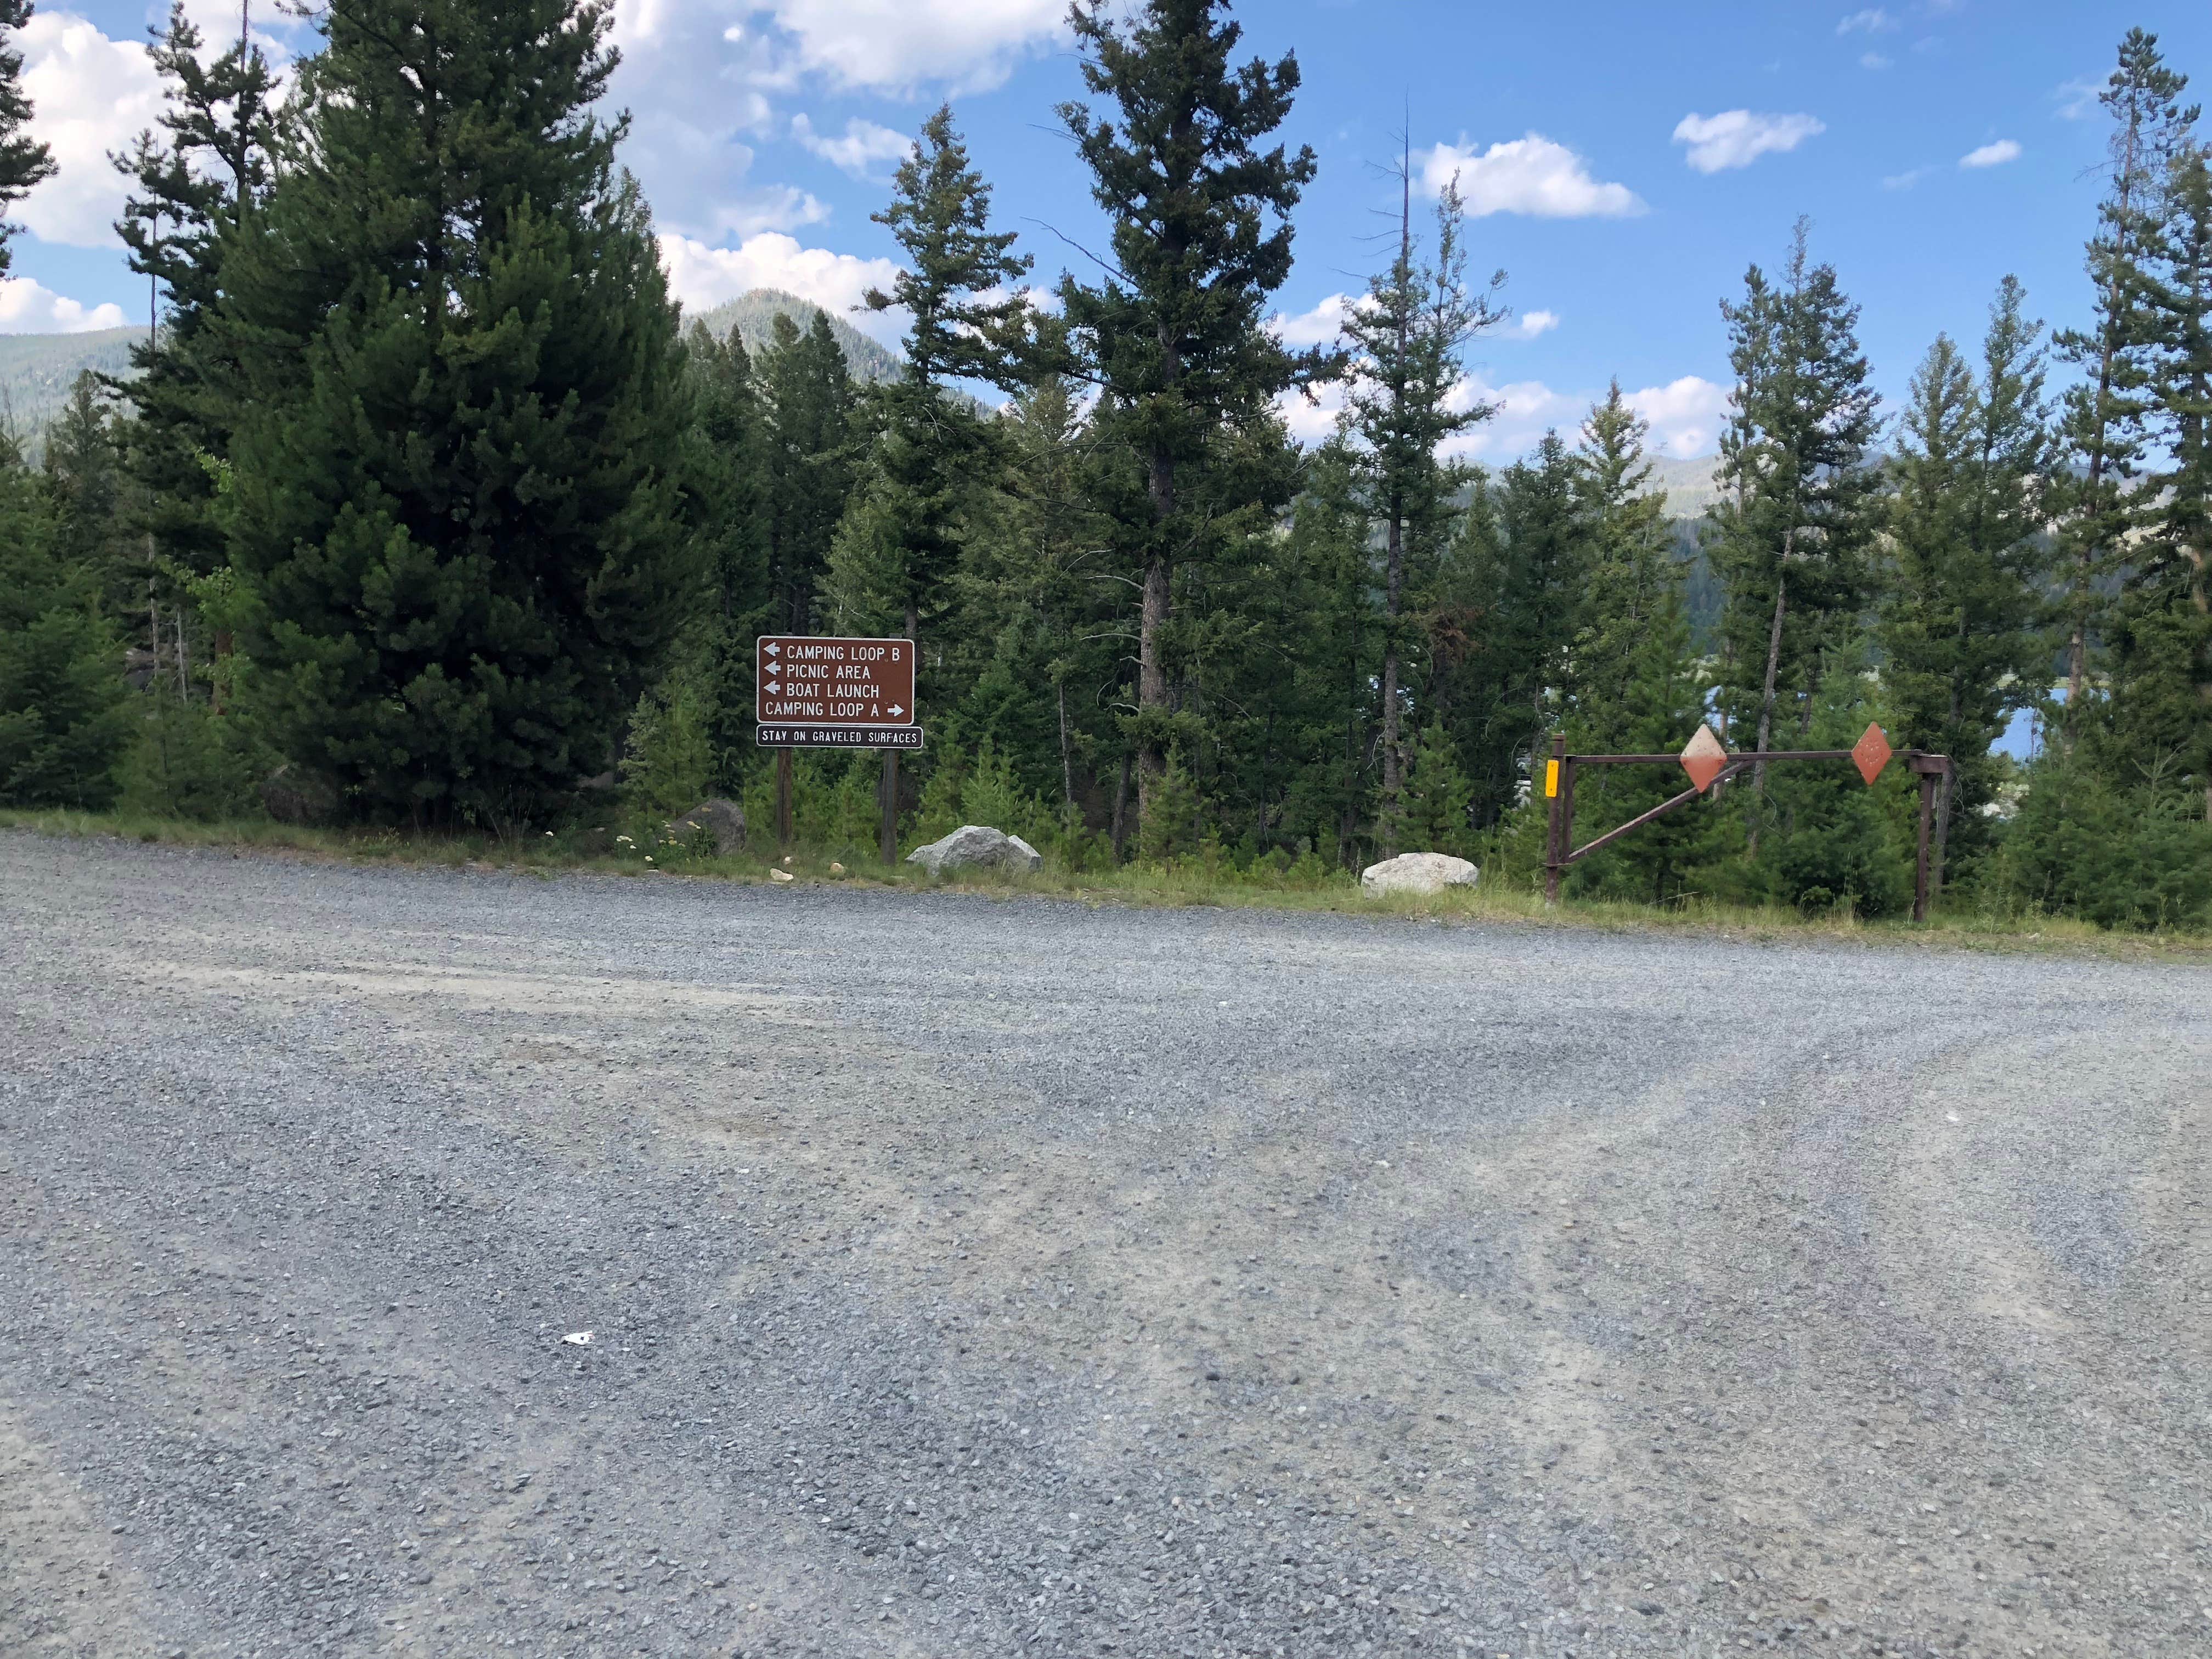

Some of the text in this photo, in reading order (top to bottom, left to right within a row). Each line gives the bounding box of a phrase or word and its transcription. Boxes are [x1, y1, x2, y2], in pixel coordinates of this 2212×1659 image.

[787, 646, 900, 661] CAMPING LOOP B
[787, 664, 871, 679] PICNIC AREA
[787, 683, 879, 698] BOAT LAUNCH
[765, 702, 879, 717] CAMPING LOOP A
[762, 731, 917, 743] STAY ON GRAVELED SURFACES
